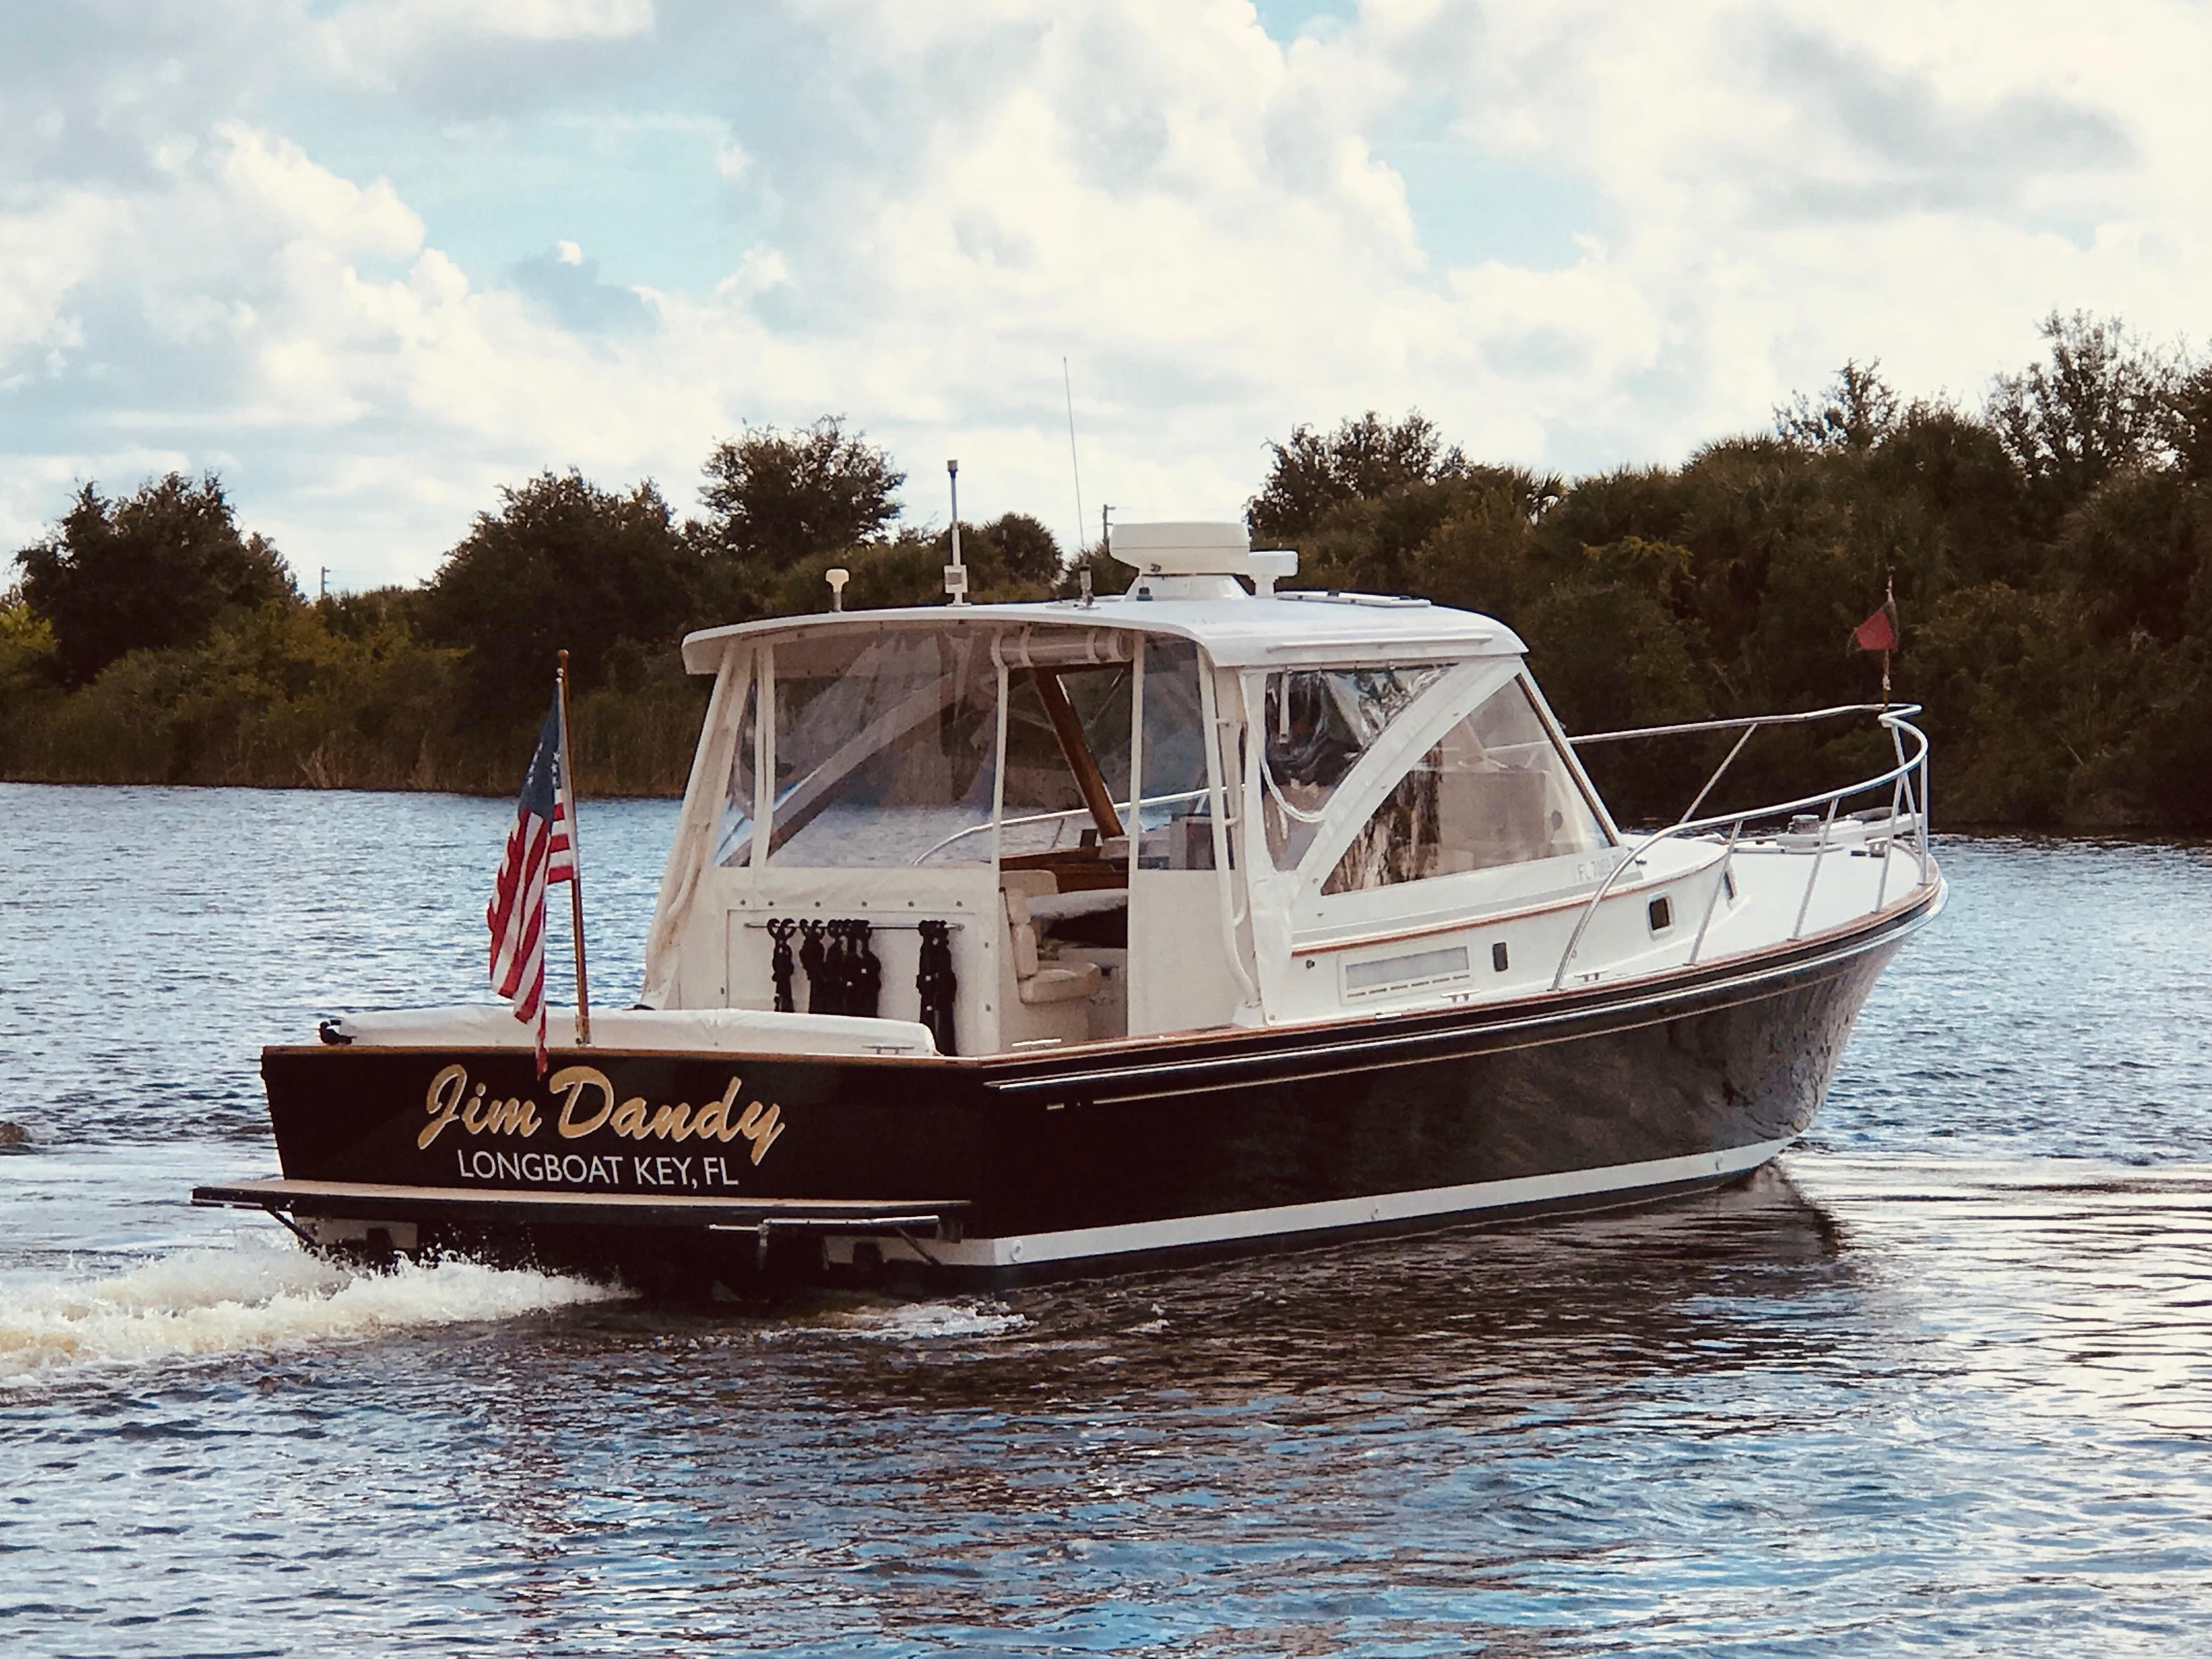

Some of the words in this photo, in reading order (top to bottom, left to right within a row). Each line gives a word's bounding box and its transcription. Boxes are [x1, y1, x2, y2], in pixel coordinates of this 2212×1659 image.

[417, 1064, 542, 1150] Jim
[549, 1065, 785, 1166] Dandy
[457, 1149, 623, 1184] LONGBOAT
[634, 1156, 698, 1189] KEY,
[703, 1156, 739, 1186] FL
